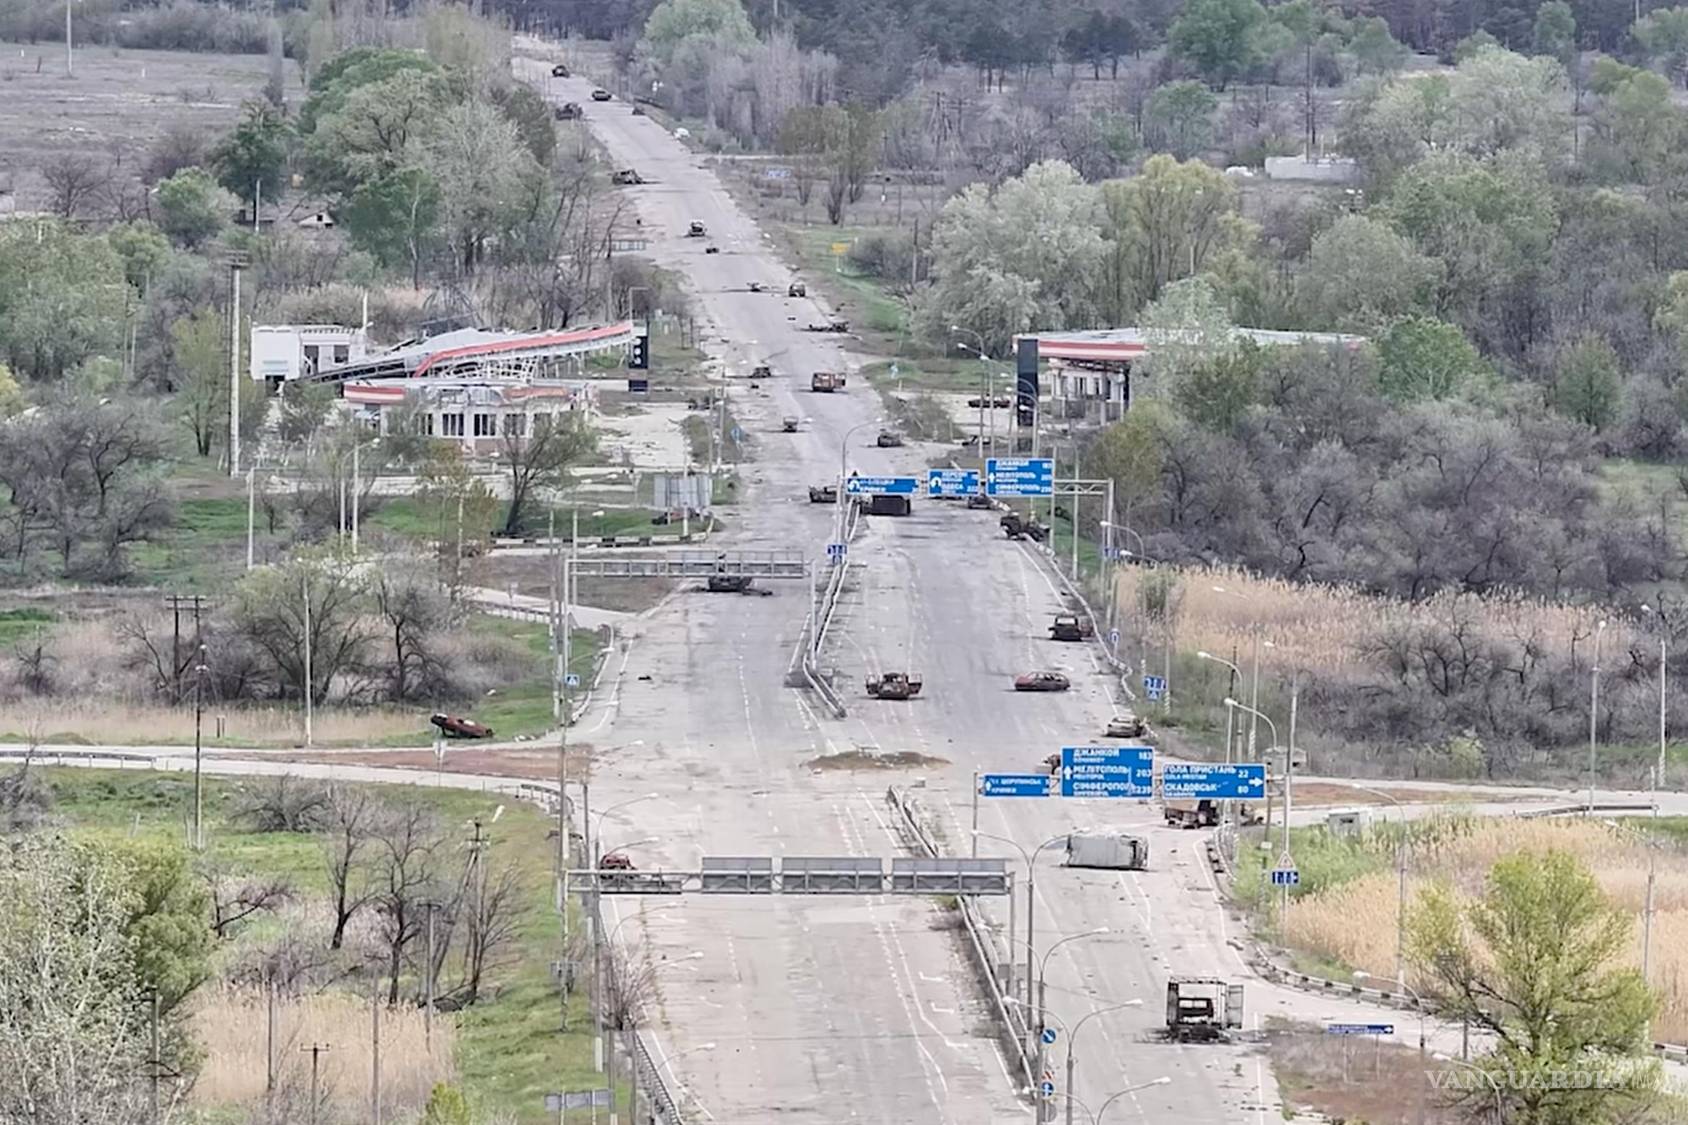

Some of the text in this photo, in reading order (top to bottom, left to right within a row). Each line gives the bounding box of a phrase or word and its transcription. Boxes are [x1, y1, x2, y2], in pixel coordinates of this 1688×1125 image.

[1073, 748, 1120, 758] ДЖАНКОЙ
[1136, 769, 1152, 778] 203
[1164, 766, 1249, 778] ГОЛА ПРИСТАНЬ 22
[1238, 786, 1249, 794] 80
